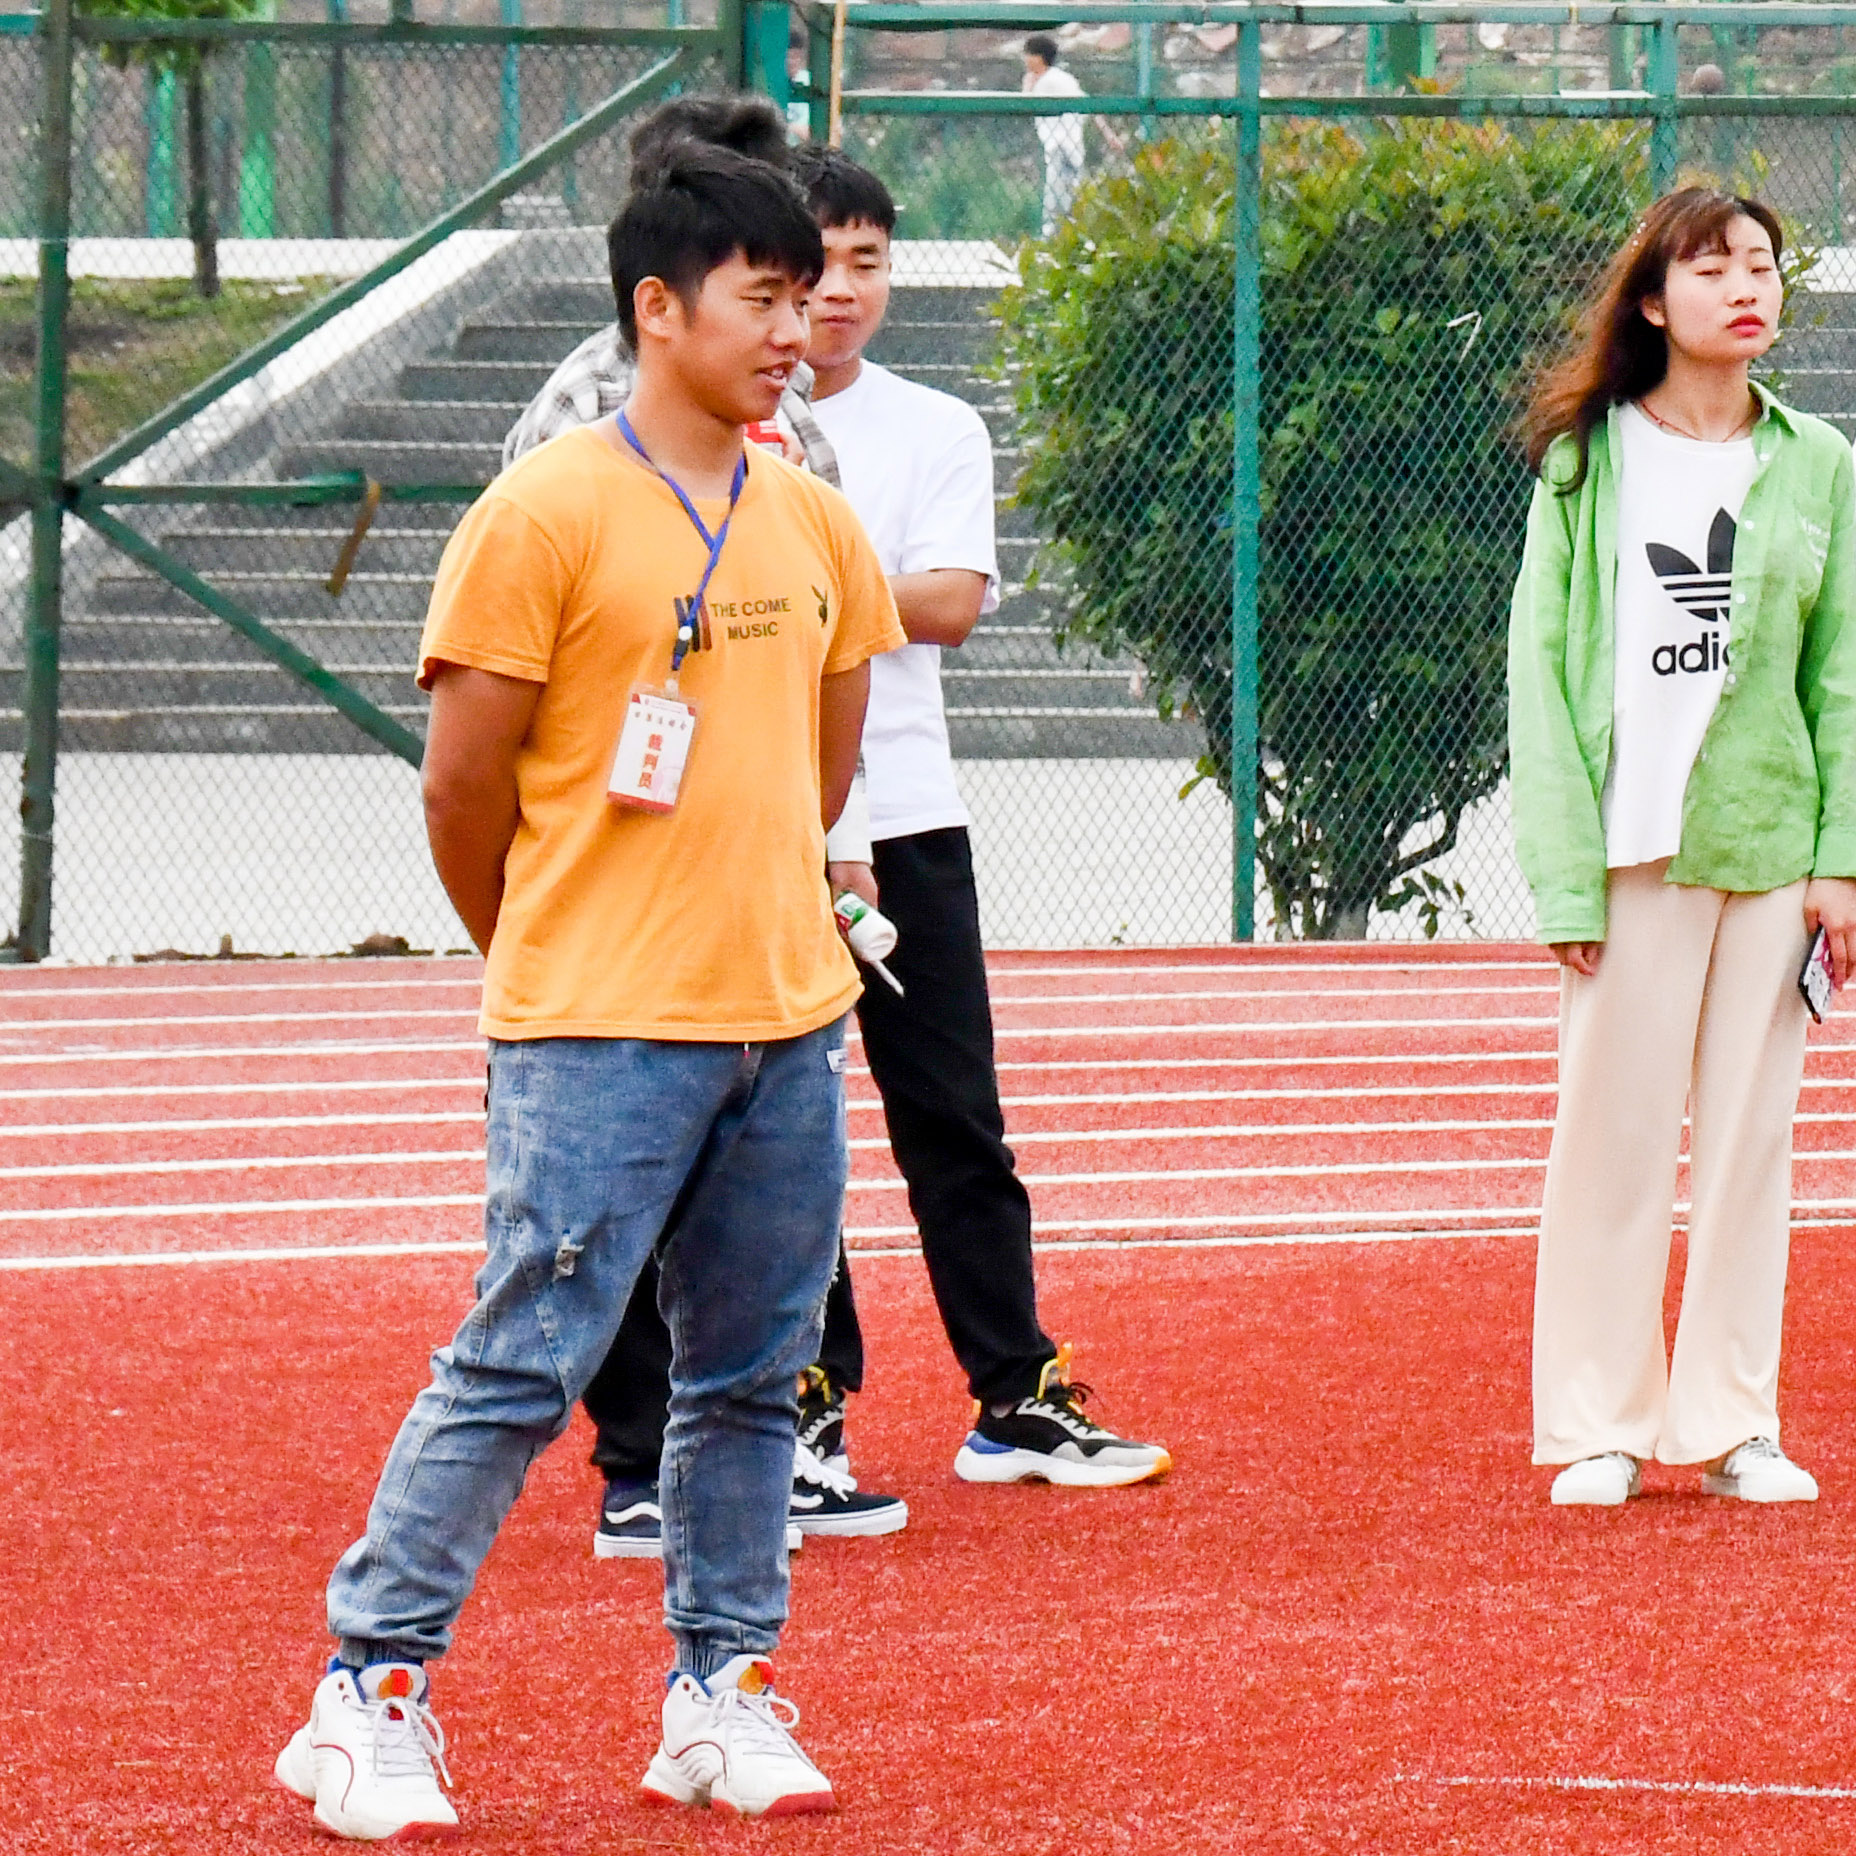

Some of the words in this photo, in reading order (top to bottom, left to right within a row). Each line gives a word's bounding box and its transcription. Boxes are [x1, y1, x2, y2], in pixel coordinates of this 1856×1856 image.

[710, 602, 738, 618] THE
[741, 597, 791, 617] COME
[727, 621, 778, 640] MUSIC
